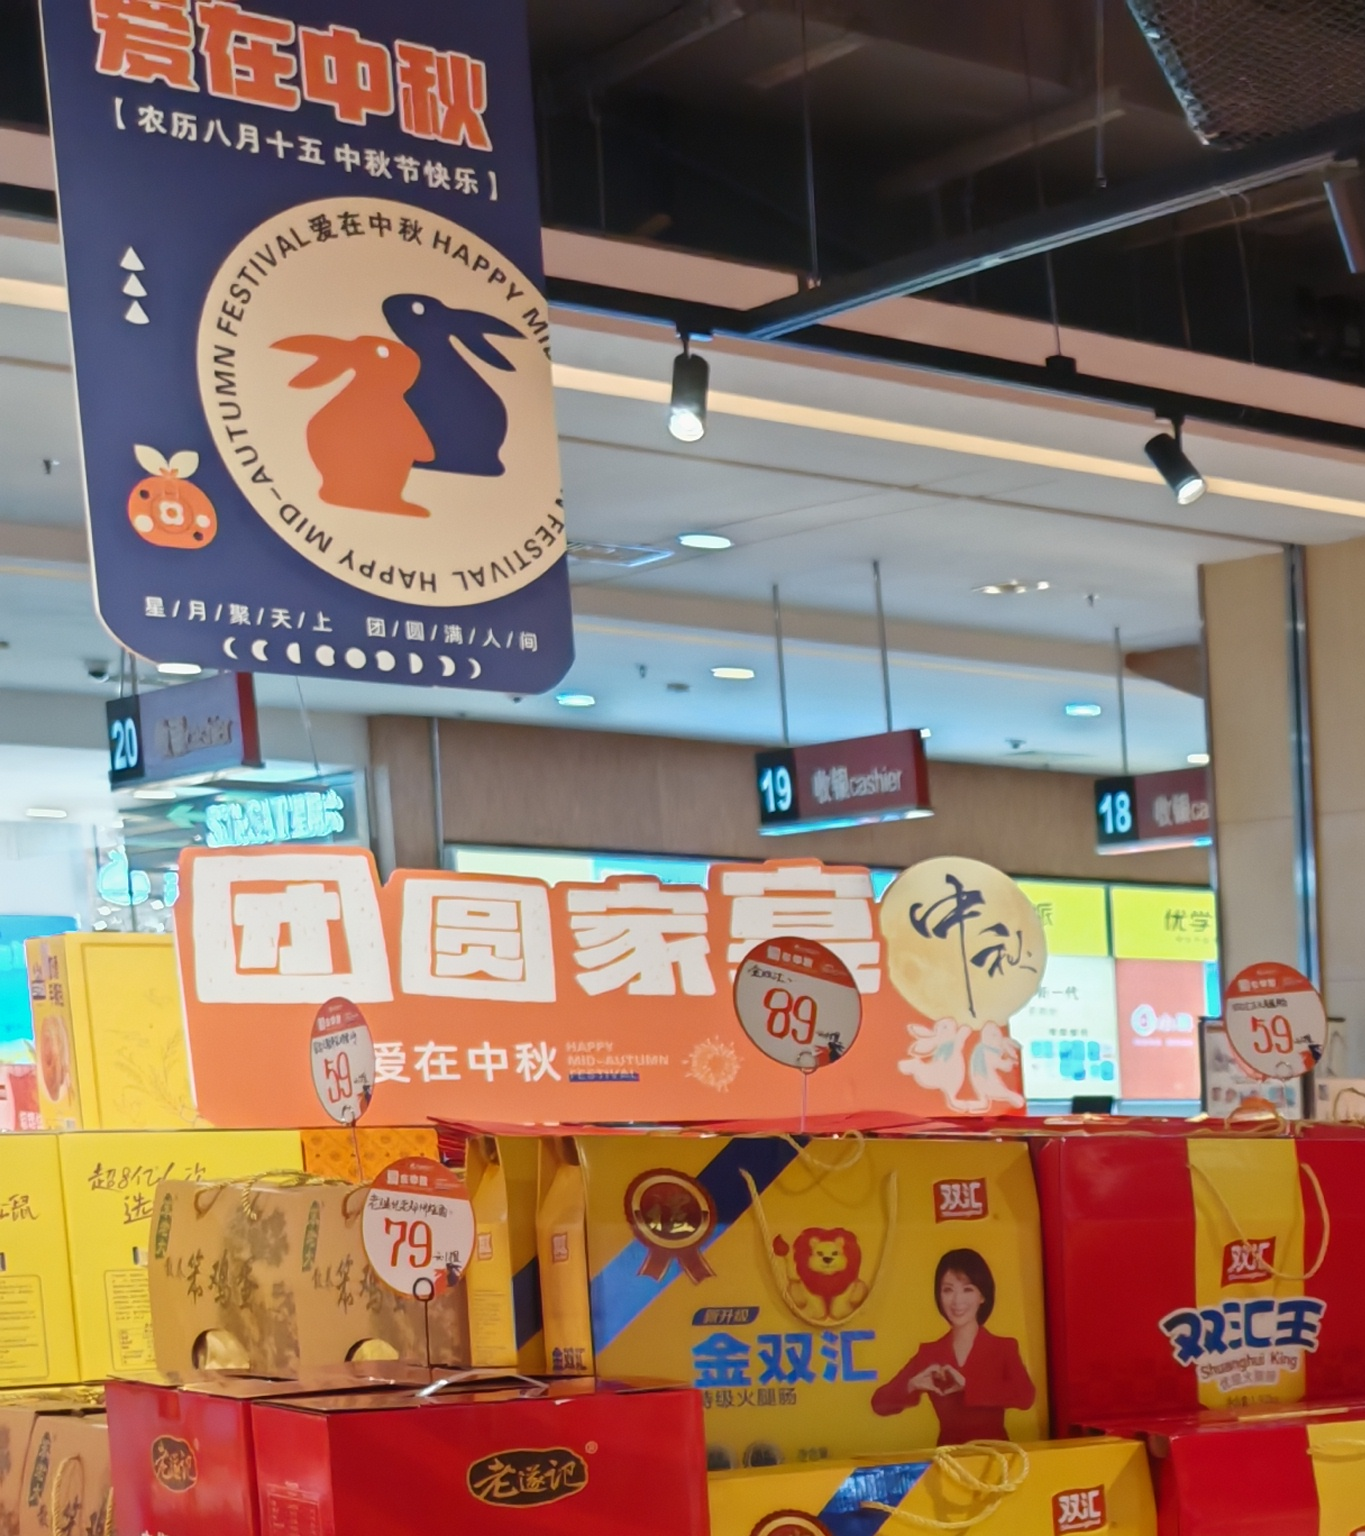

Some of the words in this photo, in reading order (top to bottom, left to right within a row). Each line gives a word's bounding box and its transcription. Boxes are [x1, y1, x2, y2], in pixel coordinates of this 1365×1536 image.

[91, 0, 492, 151] 爱在中秋
[308, 211, 425, 246] 爱在中秋
[217, 230, 312, 338] FESTIVAL
[432, 230, 524, 304] HAPPY
[338, 547, 438, 594] HAPPY
[110, 716, 139, 771] 20
[759, 767, 794, 812] 19
[1098, 792, 1133, 835] 18
[761, 987, 818, 1045] 89
[1251, 1014, 1295, 1055] 59
[374, 1040, 563, 1085] 爱在中秋
[565, 1040, 615, 1054] HAPPY
[322, 1050, 354, 1104] 59
[938, 1182, 983, 1211] 双汇
[384, 1215, 433, 1269] 79
[1160, 1299, 1325, 1365] 双汇王
[690, 1330, 879, 1389] 金双汇
[1200, 1352, 1266, 1380] Shuanghui
[1269, 1350, 1299, 1371] King
[1058, 1489, 1100, 1524] 双汇
